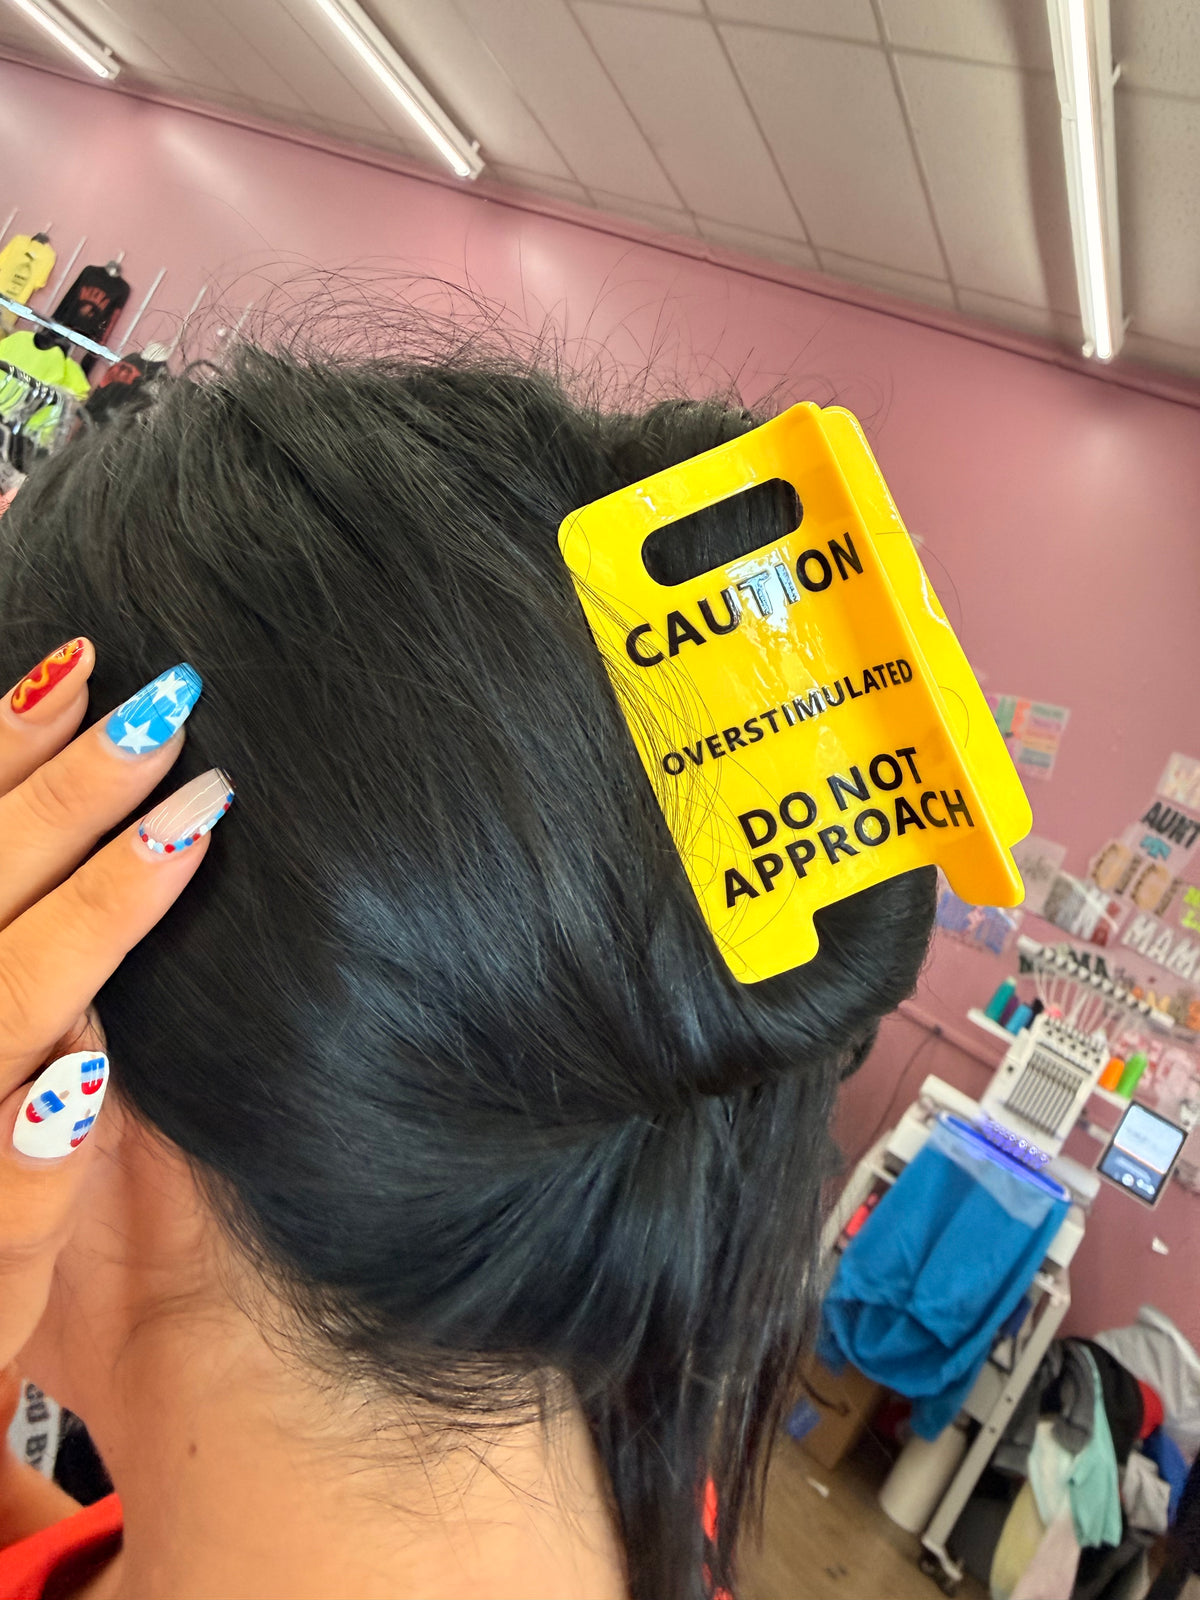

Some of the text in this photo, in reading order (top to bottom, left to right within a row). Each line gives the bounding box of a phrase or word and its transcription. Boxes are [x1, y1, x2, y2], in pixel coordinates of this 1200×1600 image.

[625, 531, 864, 668] CAUTION
[662, 658, 913, 776] OVERSTIMULATED
[724, 789, 975, 909] APPROACH
[738, 746, 923, 849] DO NOT
[1141, 801, 1200, 849] AUNT
[1122, 914, 1200, 981] MAM
